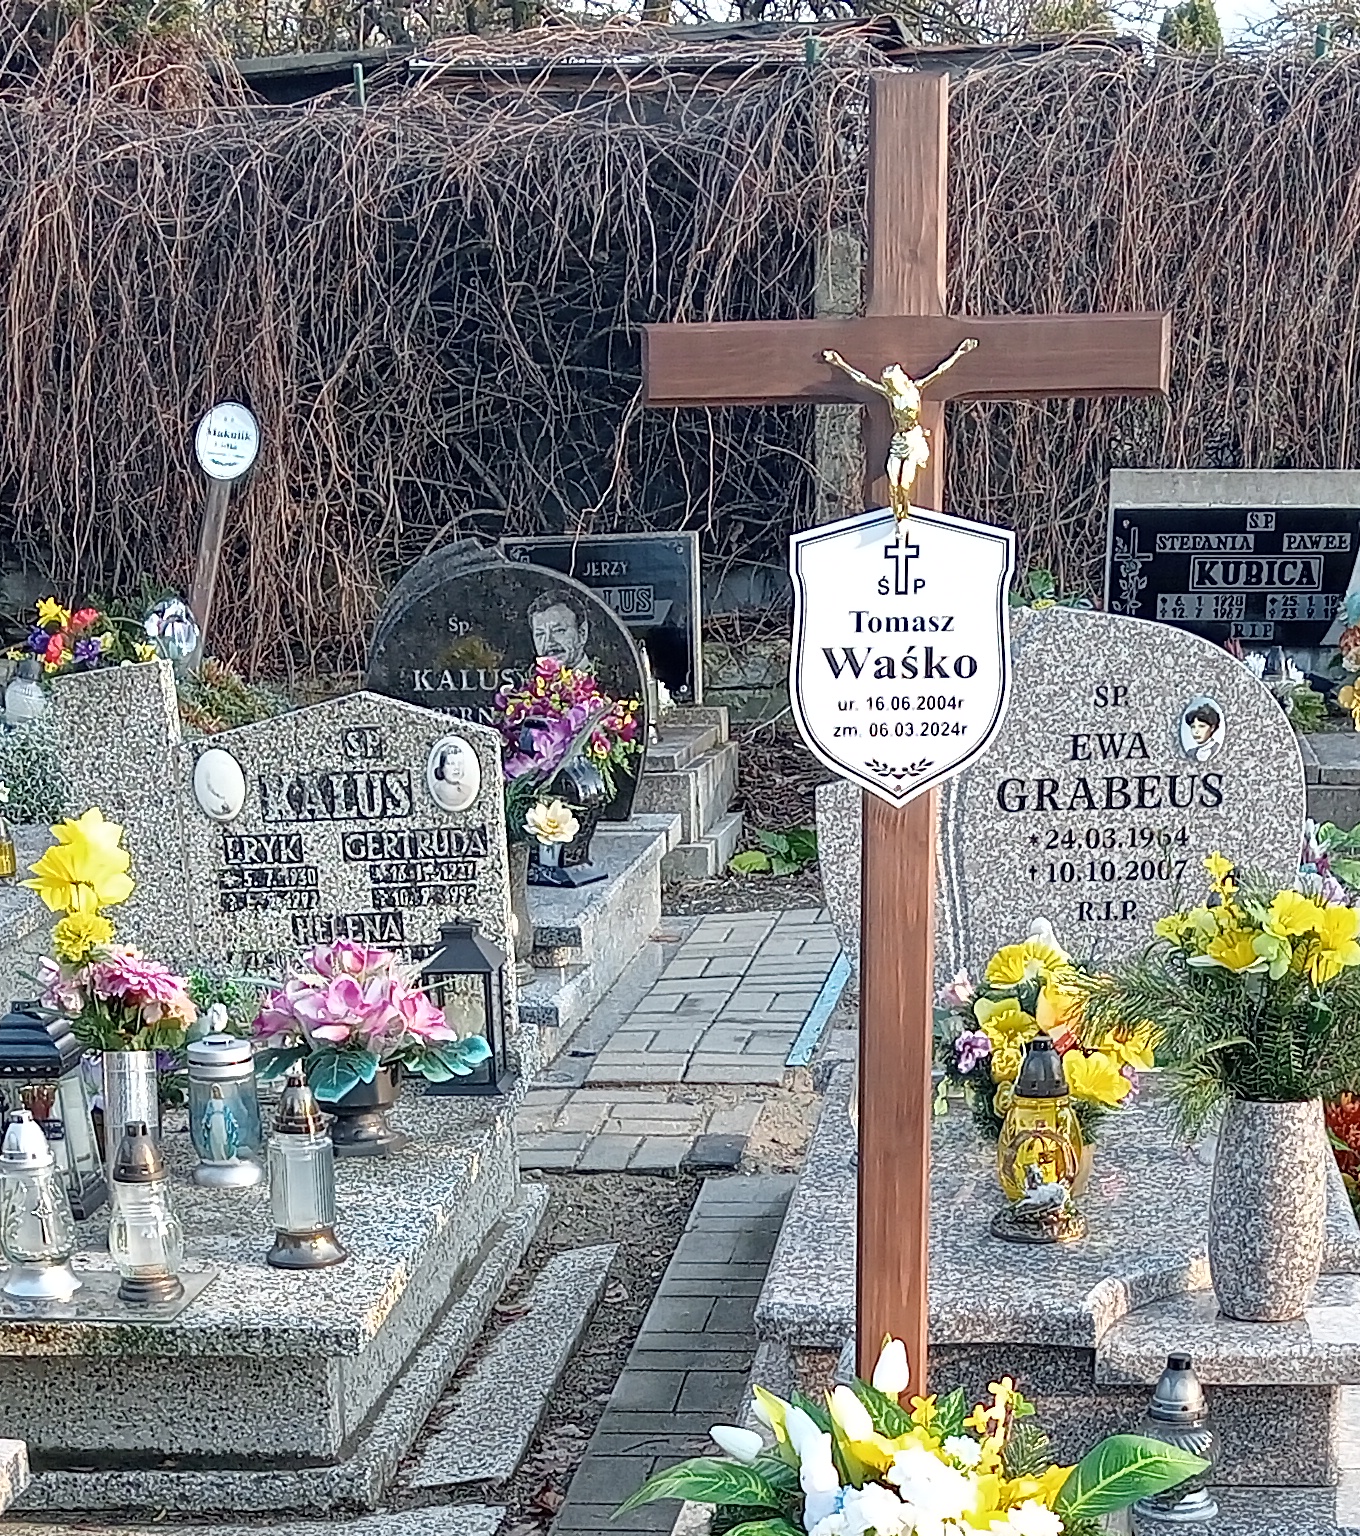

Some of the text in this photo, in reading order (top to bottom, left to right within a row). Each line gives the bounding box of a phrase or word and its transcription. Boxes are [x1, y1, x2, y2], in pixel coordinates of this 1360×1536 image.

[1156, 534, 1253, 551] STEFANIA
[582, 560, 629, 577] JERZY
[1195, 560, 1317, 586] KUBICA
[913, 578, 926, 595] P
[602, 588, 652, 614] LUS
[1324, 594, 1341, 606] 19
[848, 610, 956, 634] Tomasz
[820, 644, 979, 680] Waśko
[412, 668, 517, 692] KALUS
[837, 695, 966, 712] ur. 16.06.2004r
[832, 721, 969, 738] zm. 06.03.2024r
[1069, 732, 1151, 761] EWA
[259, 771, 412, 821] KALUS
[996, 772, 1224, 813] GRABEUS
[225, 834, 303, 864] ERYK
[344, 830, 487, 861] GERTRUDA
[1045, 825, 1190, 850] 24.03.1964
[1048, 858, 1189, 883] 10.10.2007
[1077, 900, 1138, 922] R.I.P.
[293, 913, 403, 944] HELENA
